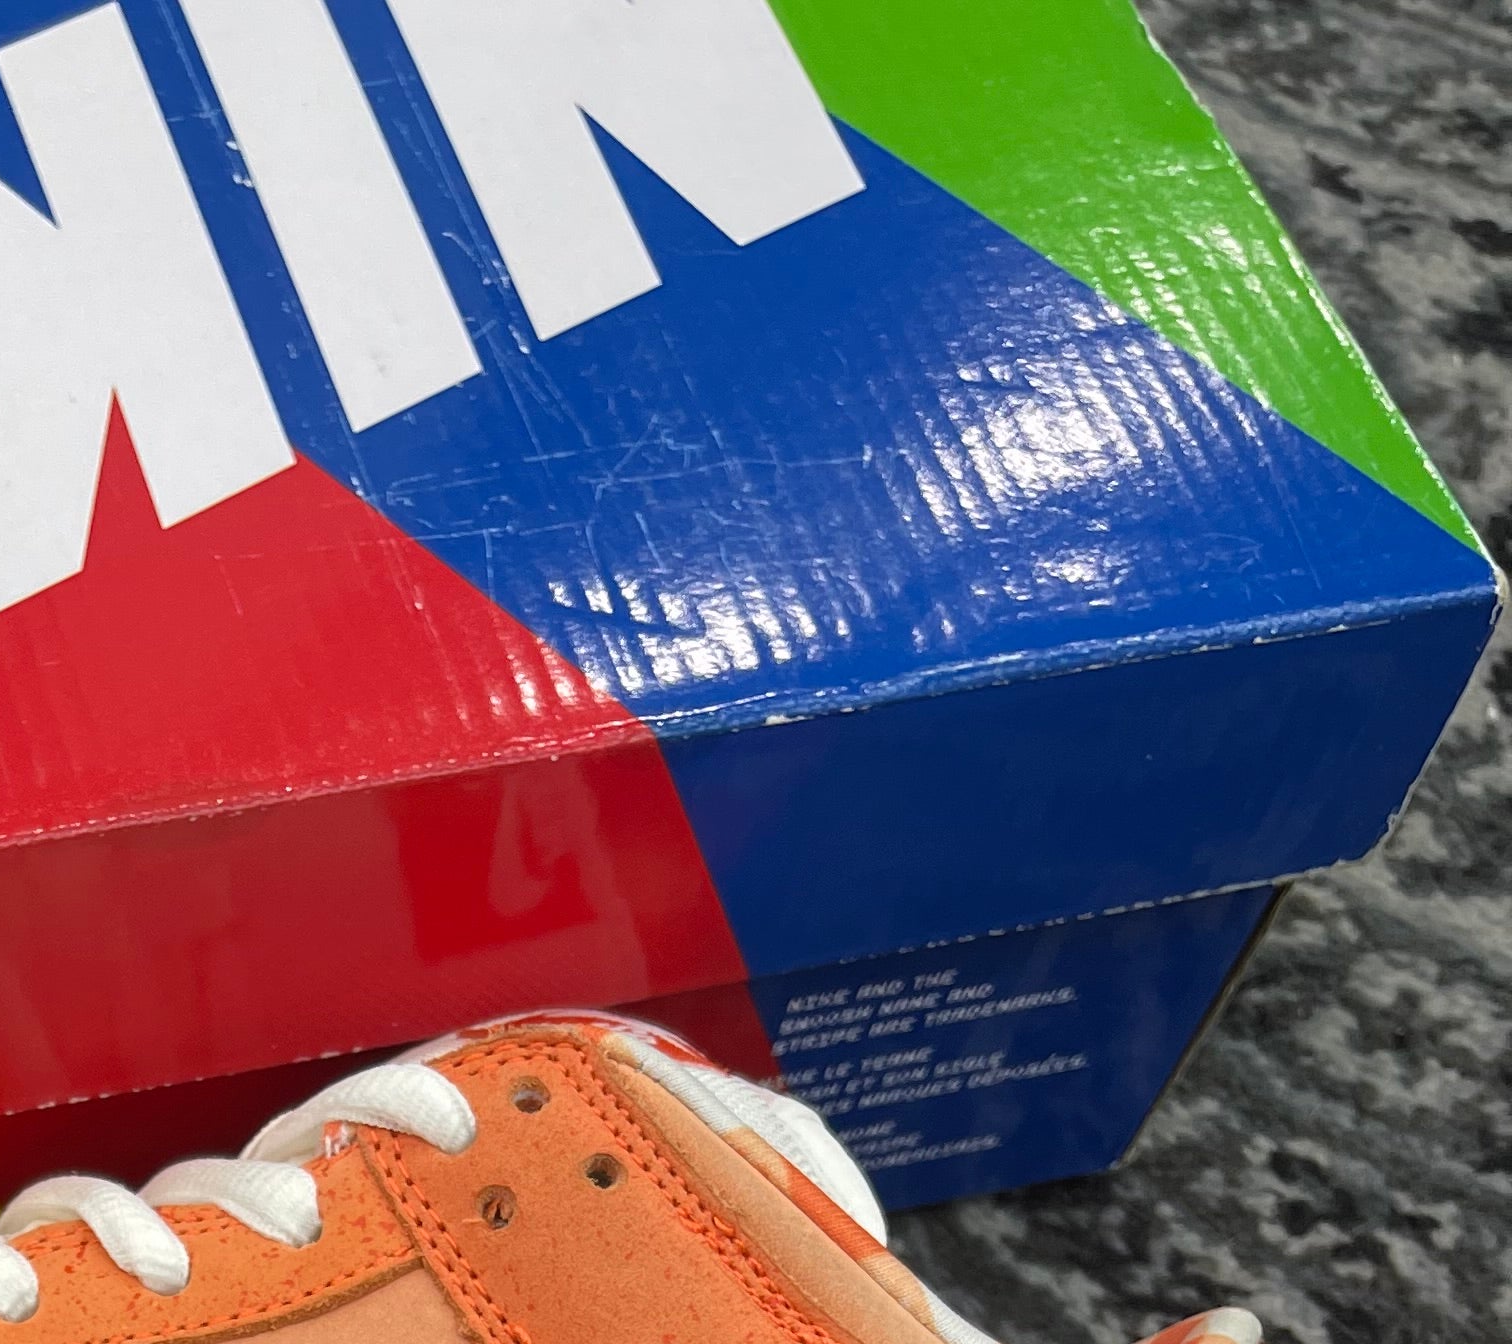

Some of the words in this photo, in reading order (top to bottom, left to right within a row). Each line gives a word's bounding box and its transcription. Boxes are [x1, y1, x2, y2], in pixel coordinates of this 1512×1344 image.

[779, 1004, 874, 1036] SWOOSH
[878, 992, 941, 1016] NAME
[946, 983, 995, 1003] AND
[786, 988, 851, 1013] NIKE
[856, 979, 905, 1000] AND
[914, 968, 959, 990] THE
[770, 1026, 864, 1057] STRIPE
[868, 1016, 917, 1038] ARE
